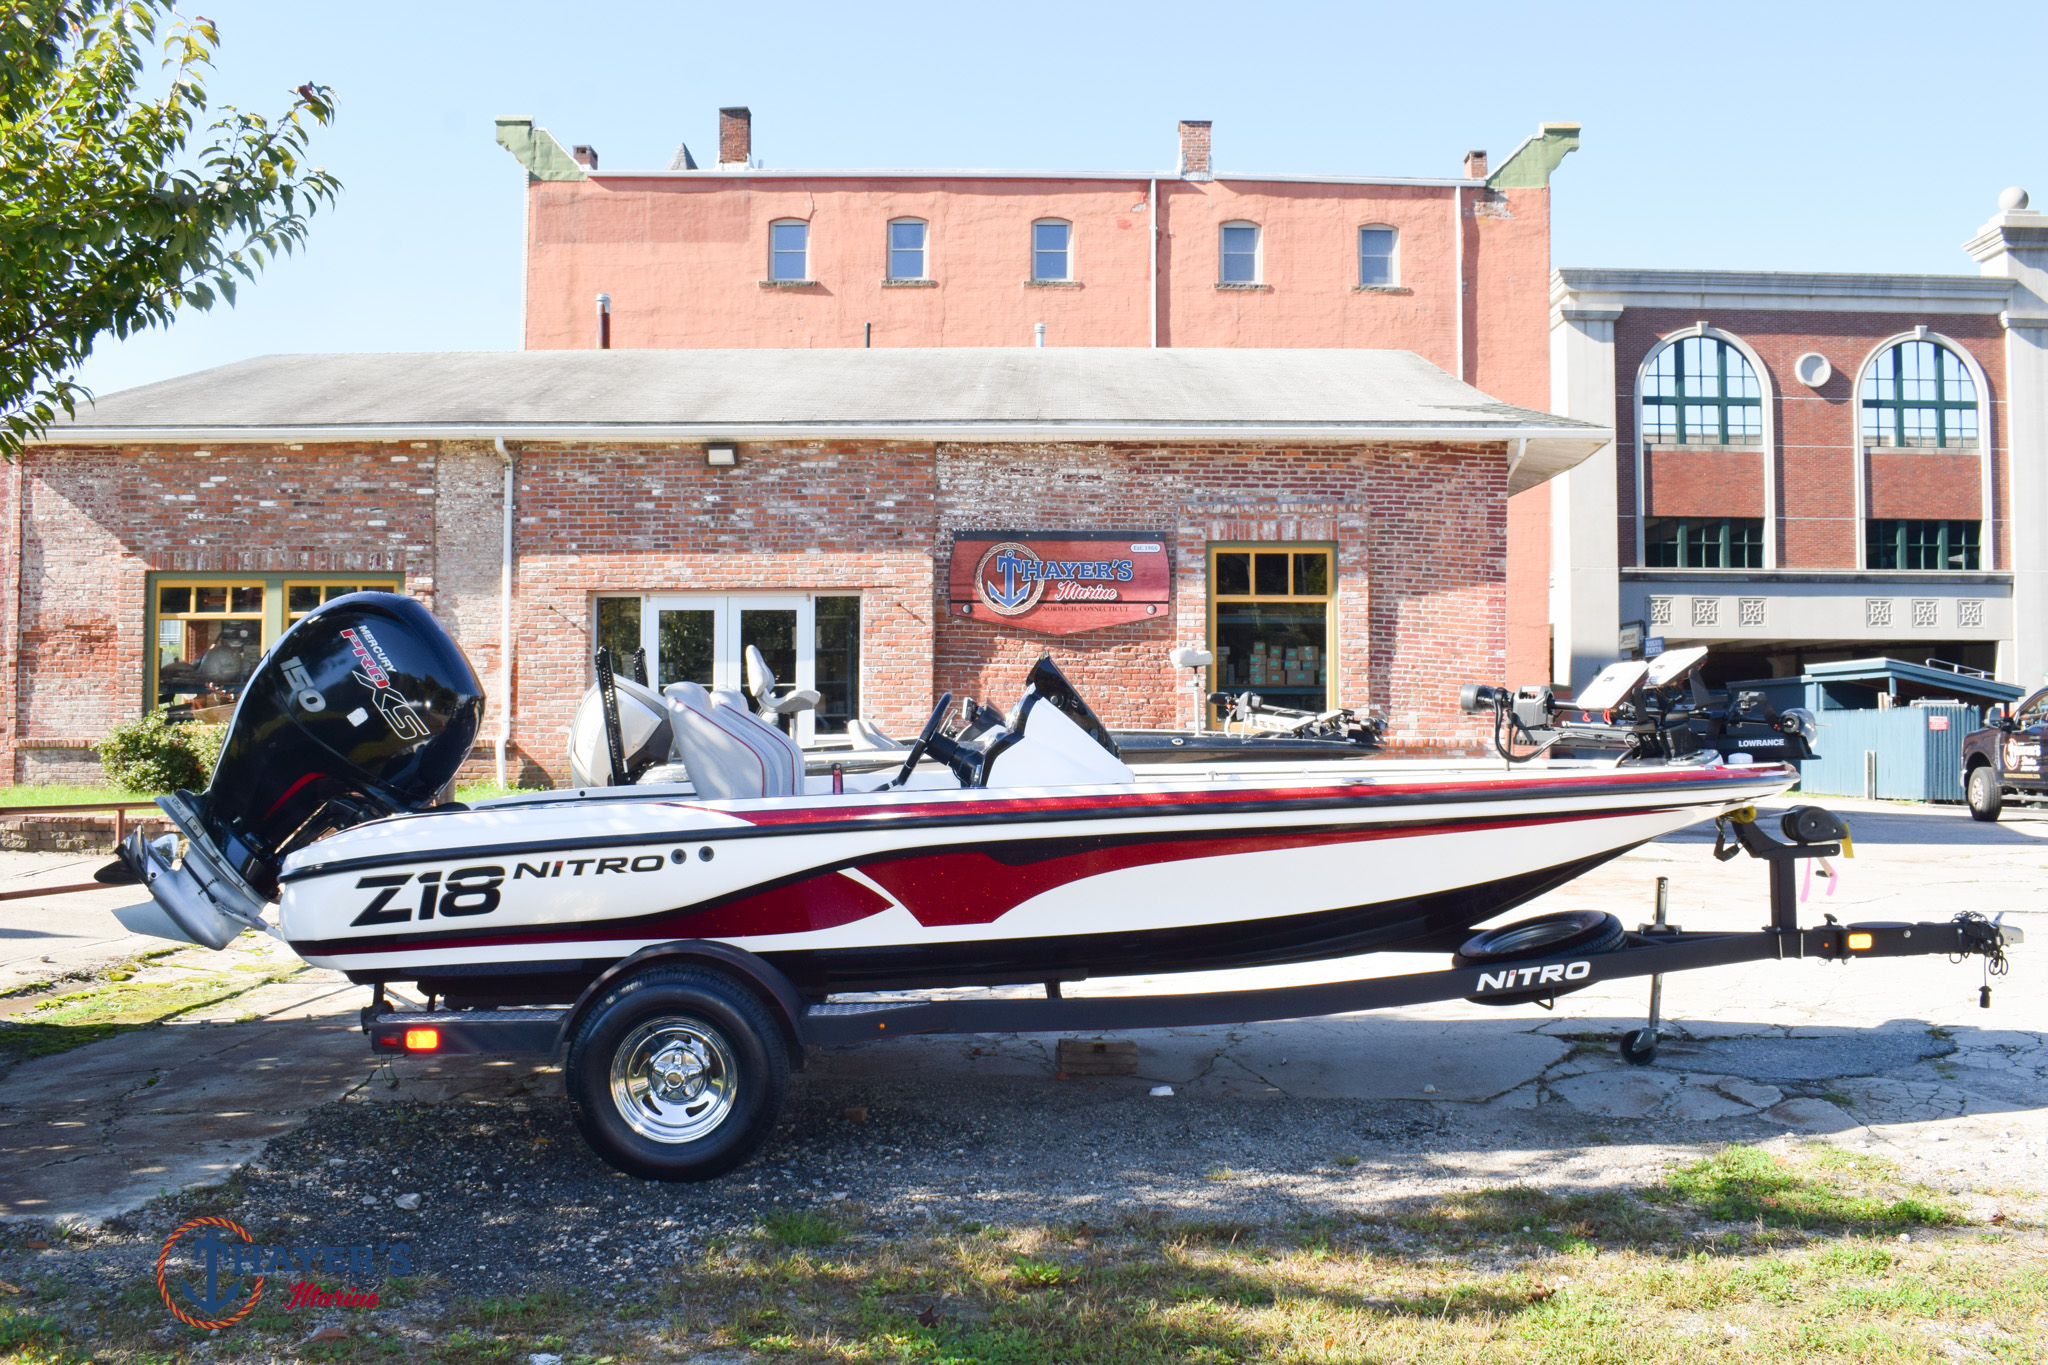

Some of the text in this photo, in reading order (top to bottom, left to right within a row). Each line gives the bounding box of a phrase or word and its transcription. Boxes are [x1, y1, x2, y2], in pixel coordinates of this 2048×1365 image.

[997, 555, 1133, 597] THAYER'S
[1055, 580, 1118, 601] Marine
[1080, 605, 1129, 613] CONNECTICUT
[340, 627, 391, 689] PRO
[358, 624, 398, 673] MERCURY
[279, 656, 327, 713] 150
[351, 669, 431, 740] XS
[1738, 738, 1785, 748] LOWRANCE
[349, 854, 665, 928] Z18 NITRO
[1475, 960, 1591, 993] NITRO
